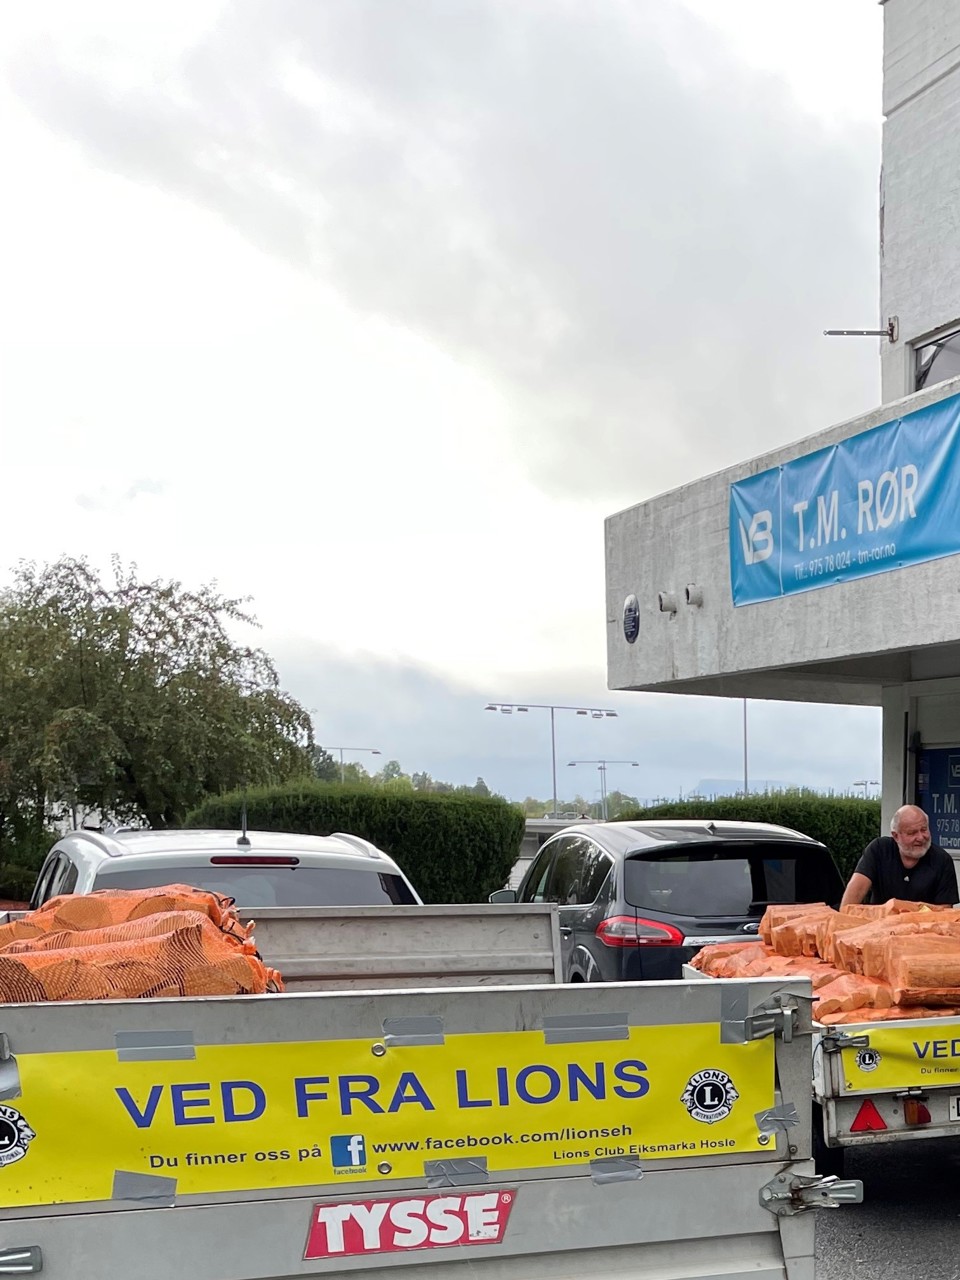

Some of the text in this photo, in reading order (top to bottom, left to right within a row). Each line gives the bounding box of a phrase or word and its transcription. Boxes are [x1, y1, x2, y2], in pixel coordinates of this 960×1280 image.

[793, 464, 919, 552] T.M. RØR
[808, 558, 823, 577] 975
[825, 554, 834, 573] 78
[835, 550, 851, 570] 024
[858, 543, 896, 565] tm-ror.no
[932, 793, 941, 814] T.
[944, 793, 958, 814] M.
[936, 818, 950, 832] 975
[951, 819, 960, 832] 78
[692, 1071, 727, 1084] LIONS
[920, 1067, 932, 1075] Du
[934, 1066, 957, 1074] finner
[115, 1059, 651, 1129] VED FRA LIONS
[703, 1086, 719, 1105] L
[150, 1154, 178, 1168] Du
[185, 1152, 247, 1167] finner
[254, 1151, 291, 1162] oss
[298, 1144, 322, 1161] på
[372, 1125, 632, 1154] www.facebook.com/lionseh
[554, 1139, 736, 1160] Lions Club Eiksmarka Hosle
[333, 1167, 367, 1176] facebook
[318, 1192, 501, 1253] TYSSE
